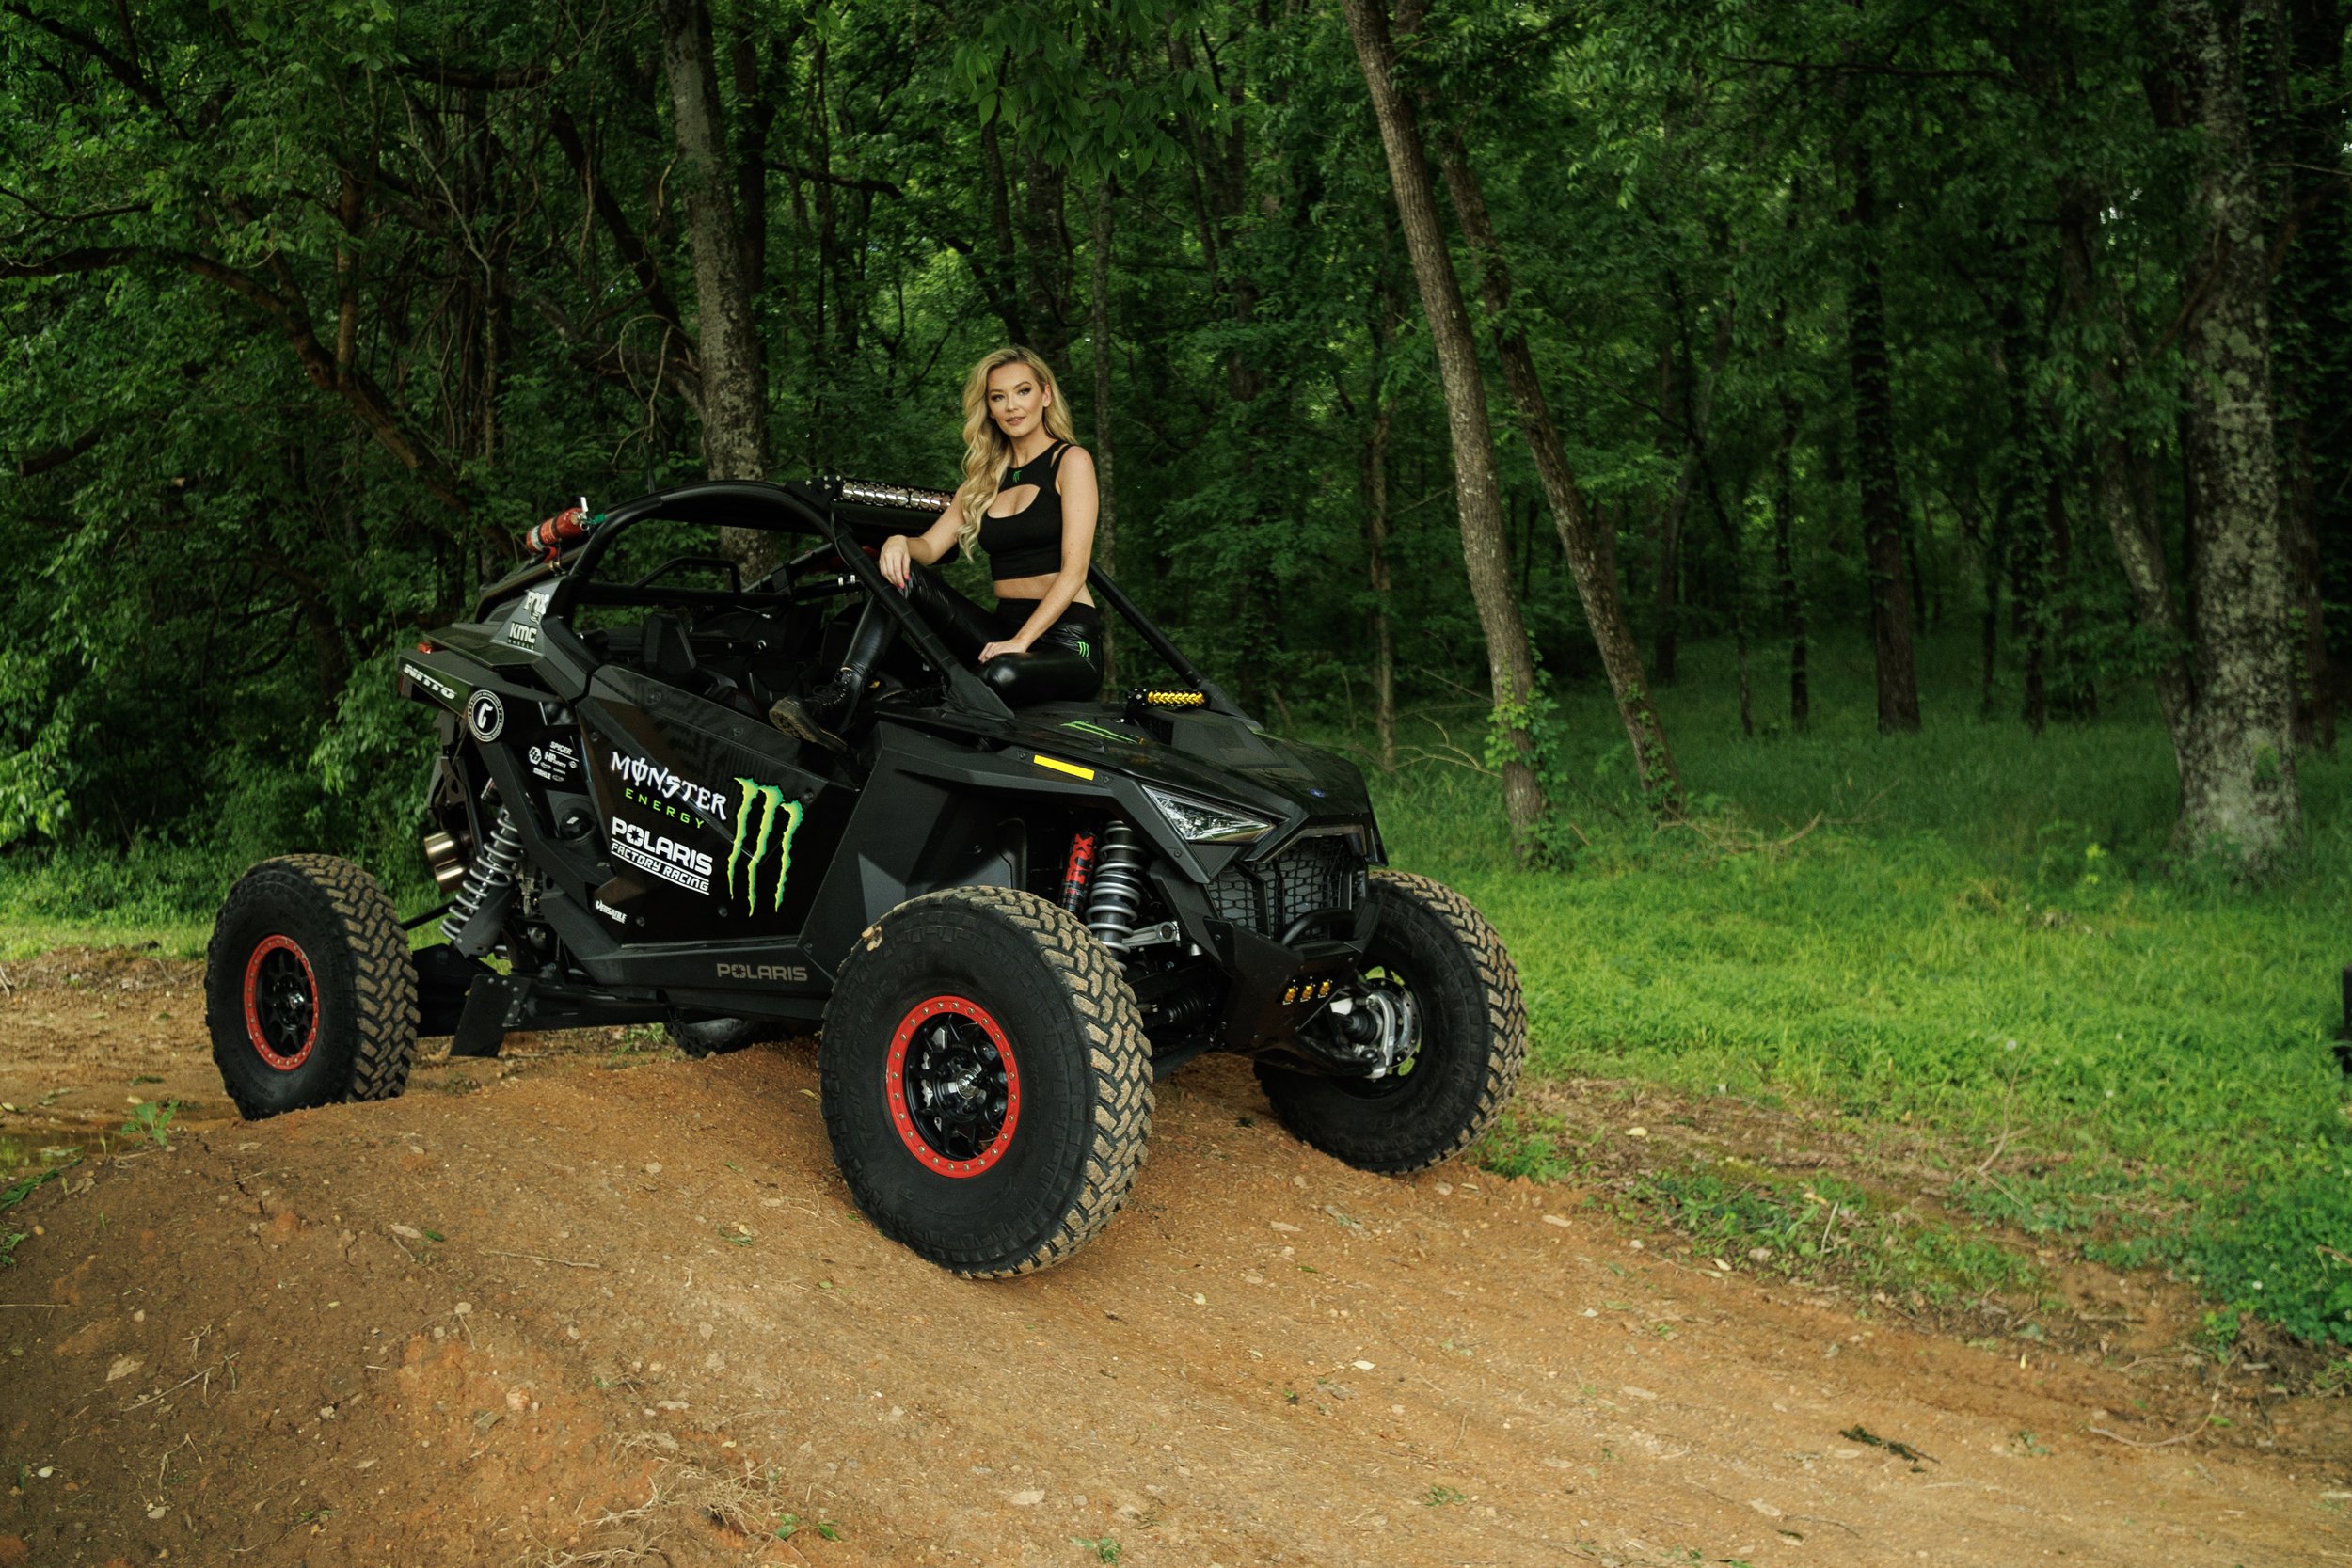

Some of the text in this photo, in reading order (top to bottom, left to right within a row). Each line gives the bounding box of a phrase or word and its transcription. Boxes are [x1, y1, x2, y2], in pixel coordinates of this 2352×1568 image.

[509, 622, 537, 644] KMC
[404, 663, 457, 700] NITTO
[549, 741, 573, 755] SPICER
[611, 751, 727, 821] MONSTER
[625, 787, 705, 829] ENERGY
[611, 842, 709, 893] FACTORY RACING
[612, 816, 713, 877] POLARIS
[1065, 832, 1095, 885] FOX
[717, 963, 808, 982] POLARIS
